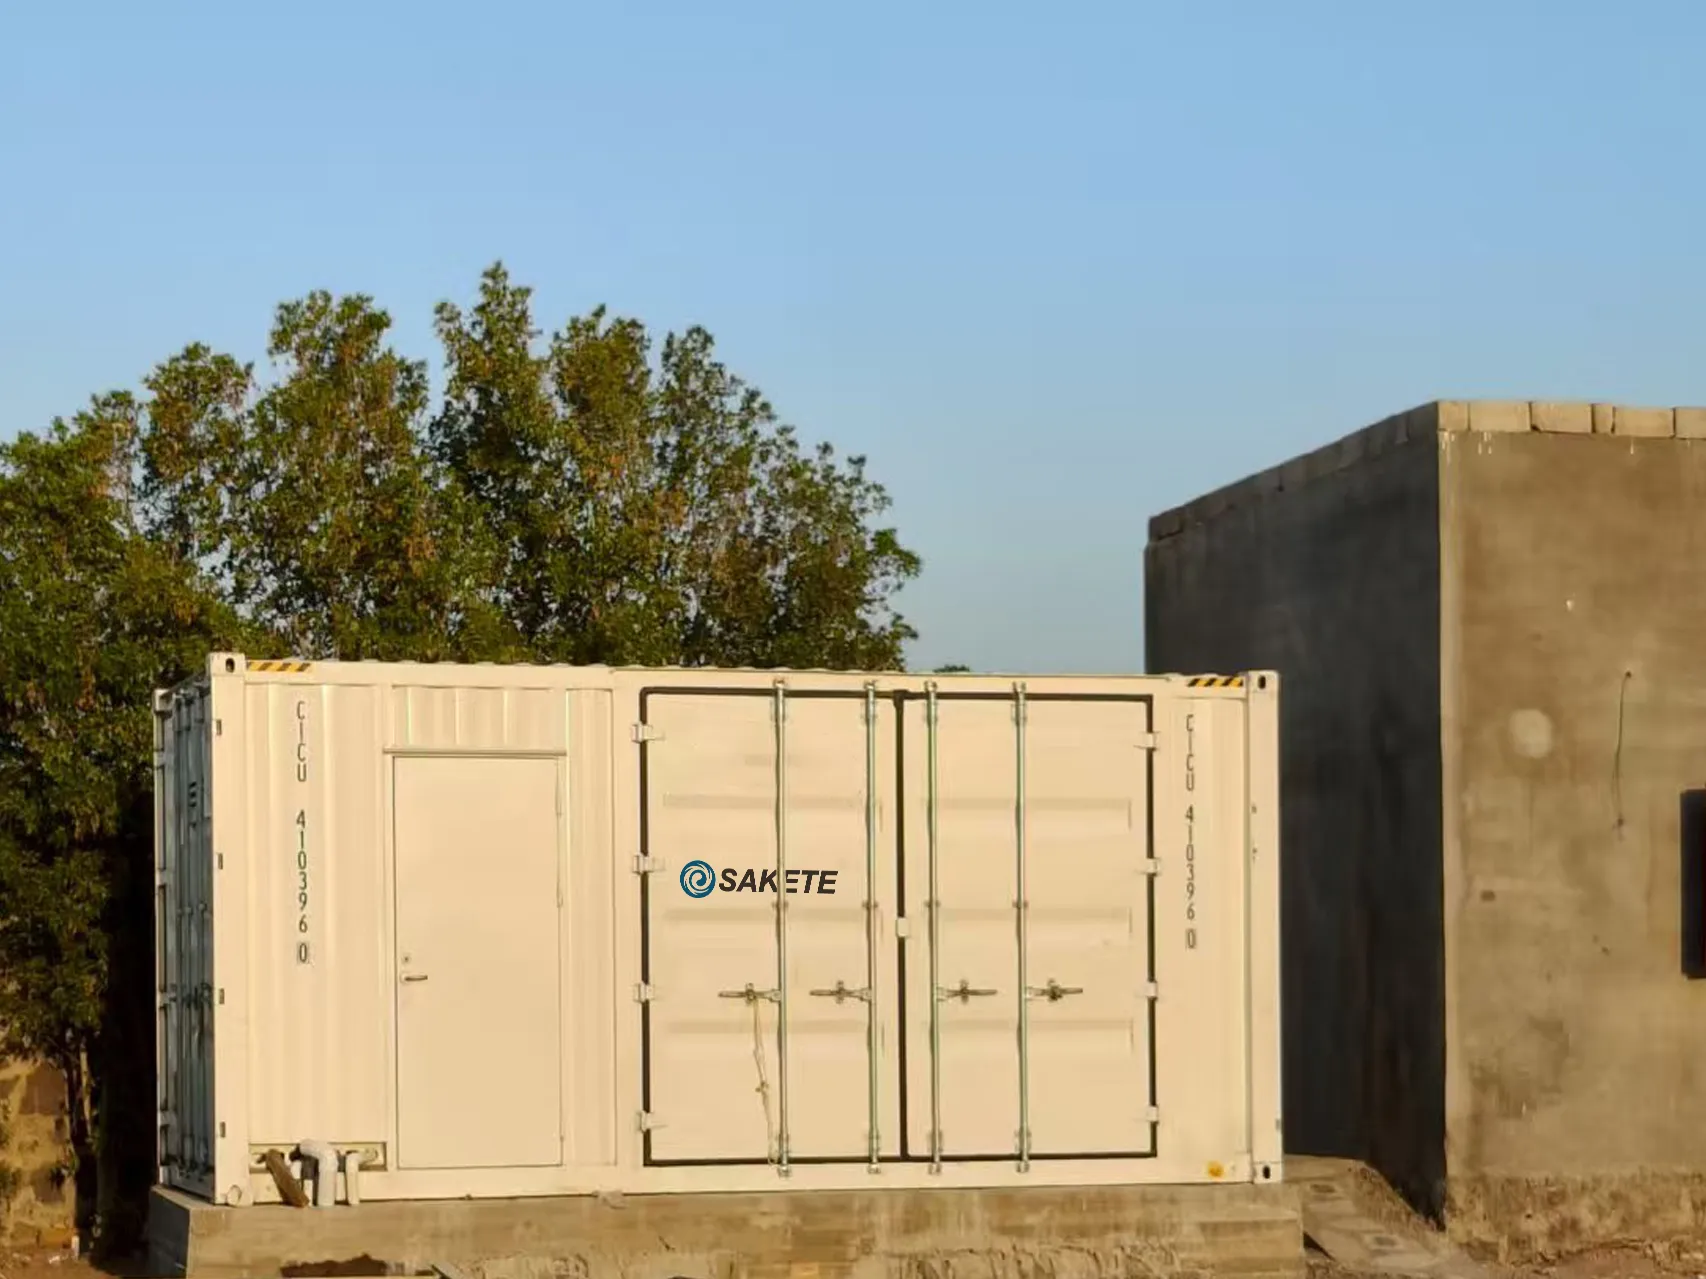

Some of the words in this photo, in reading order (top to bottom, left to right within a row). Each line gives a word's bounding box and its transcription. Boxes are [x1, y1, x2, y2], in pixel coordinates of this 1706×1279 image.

[297, 700, 307, 782] CICU
[1185, 714, 1195, 791] CICU
[719, 868, 838, 894] SAKETE
